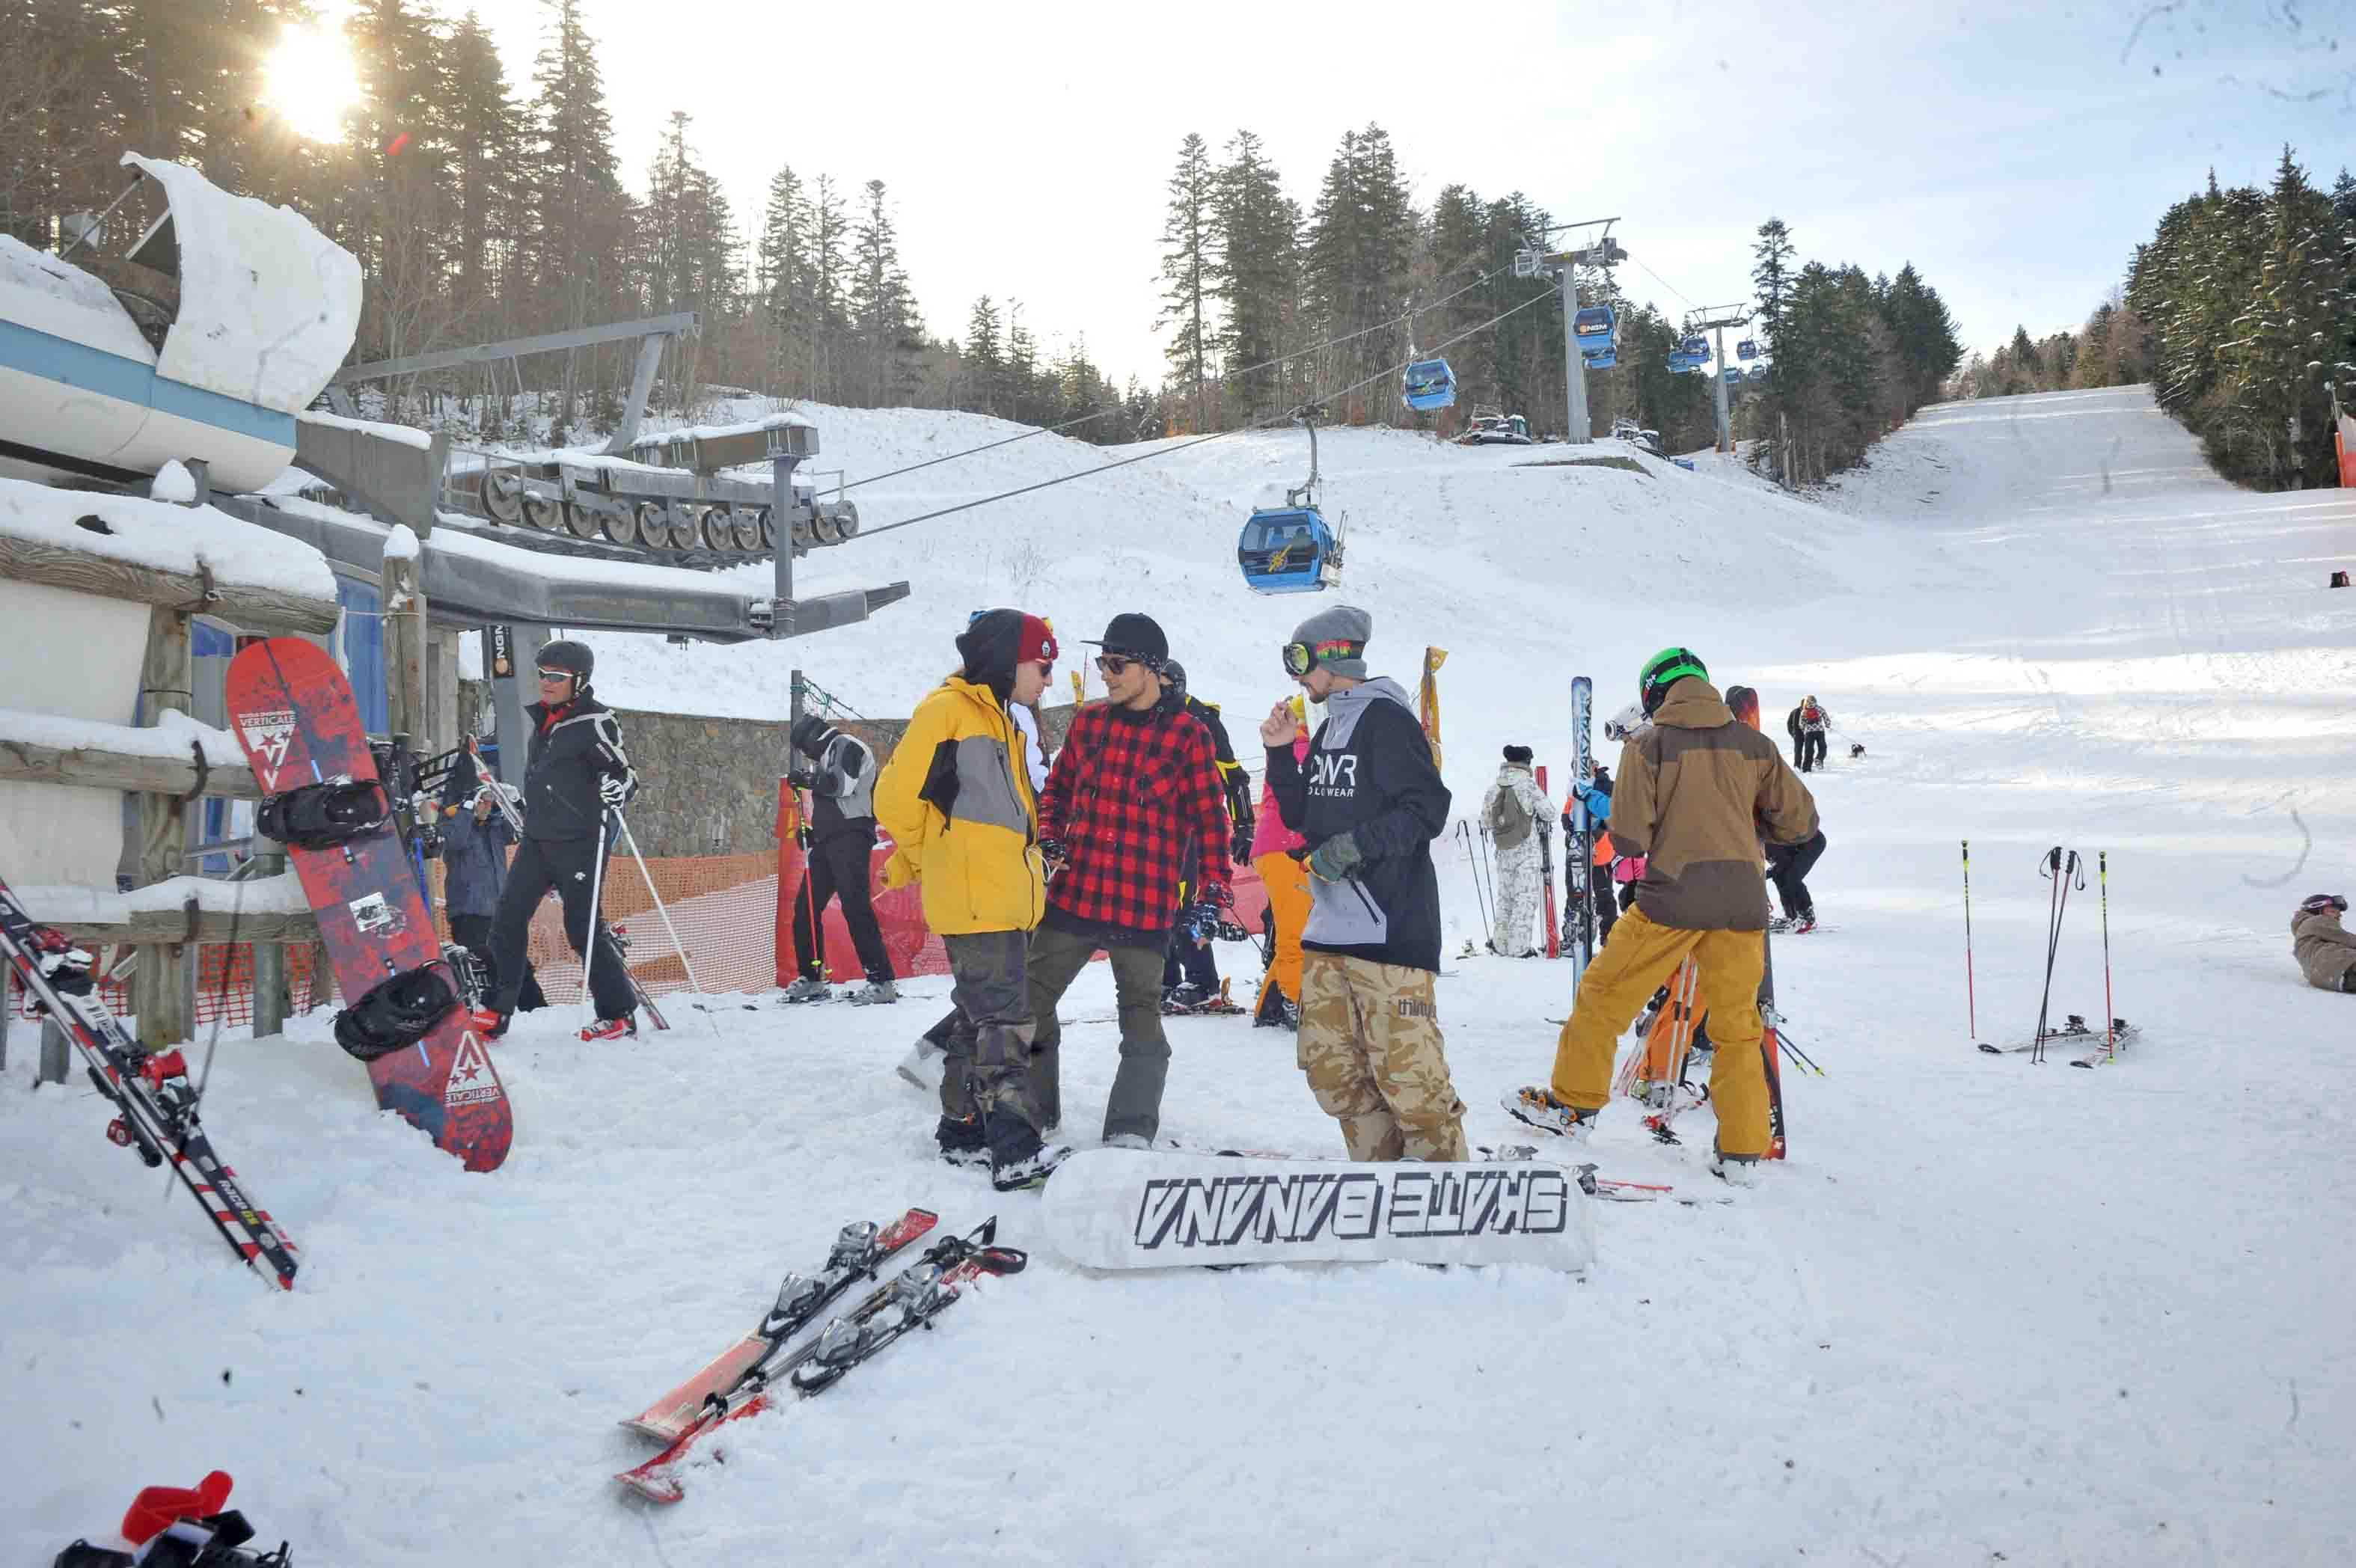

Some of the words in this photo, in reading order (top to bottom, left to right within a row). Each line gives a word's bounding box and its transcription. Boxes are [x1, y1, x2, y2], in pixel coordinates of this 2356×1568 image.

[239, 714, 296, 728] VERTICALE
[1327, 788, 1353, 797] WEAR
[445, 1088, 500, 1102] VERTICALE
[1134, 1173, 1383, 1249] BANANA
[1388, 1171, 1567, 1237] SKATE
